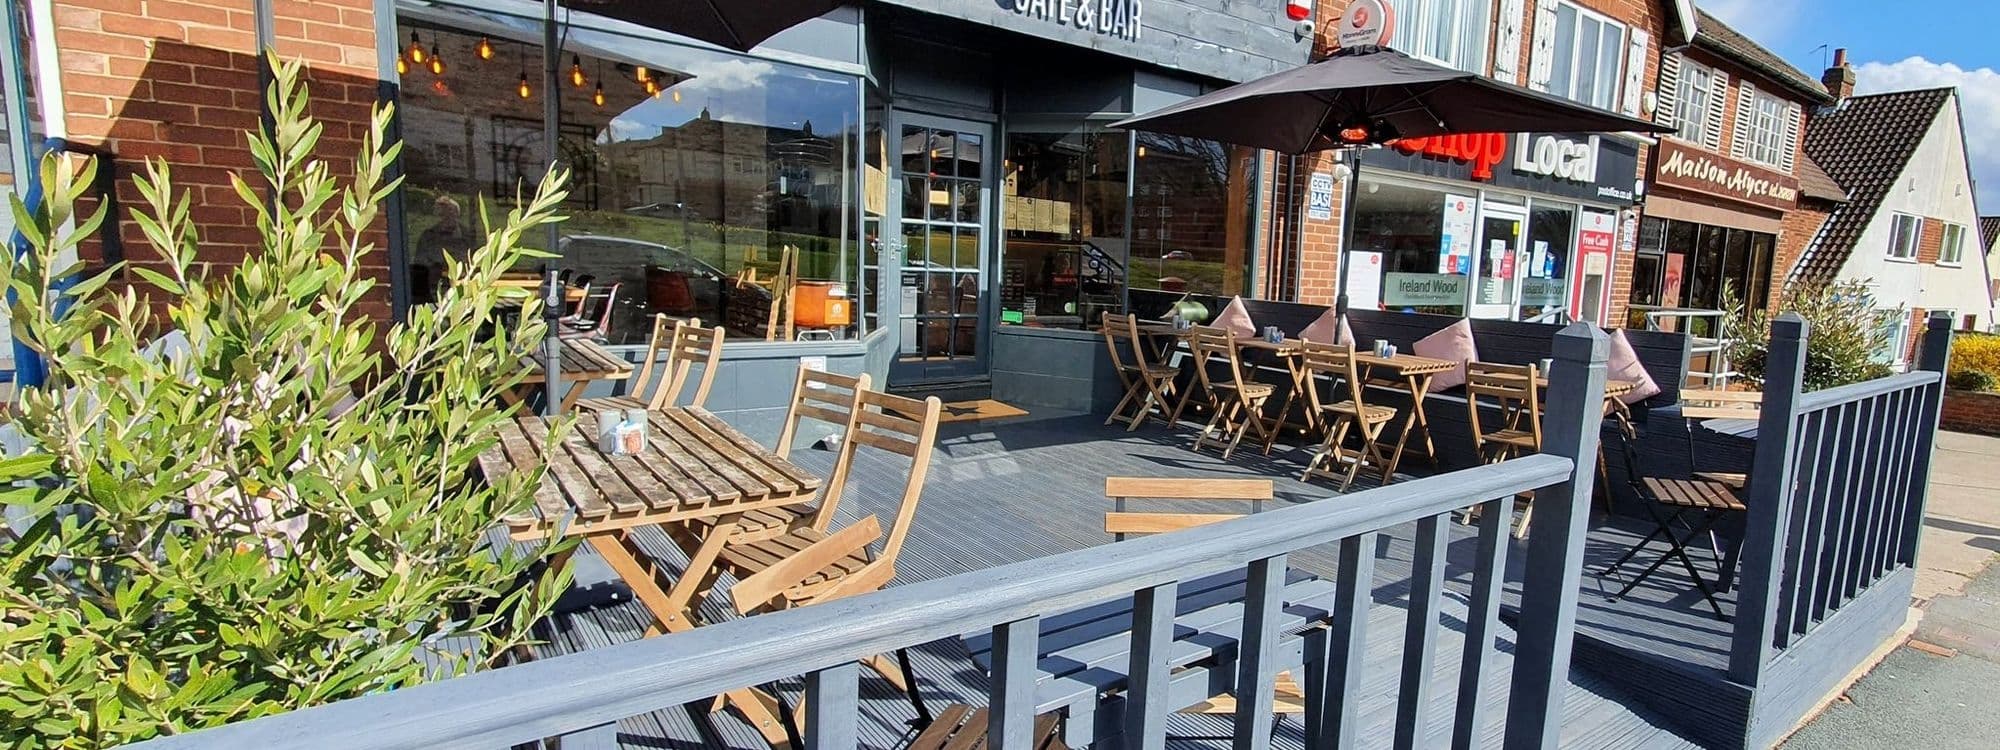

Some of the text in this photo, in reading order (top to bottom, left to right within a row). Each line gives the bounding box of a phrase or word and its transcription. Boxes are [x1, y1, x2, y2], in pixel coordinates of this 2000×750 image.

[1077, 0, 1094, 28] &
[1100, 0, 1142, 39] BAR
[1394, 132, 1600, 184] op Local
[1312, 179, 1331, 189] CCTV
[1660, 150, 1728, 185] Maison
[1727, 168, 1769, 198] Alyce
[1583, 233, 1595, 246] Free
[1595, 234, 1609, 247] Cash
[1399, 280, 1458, 293] Ireland Wood
